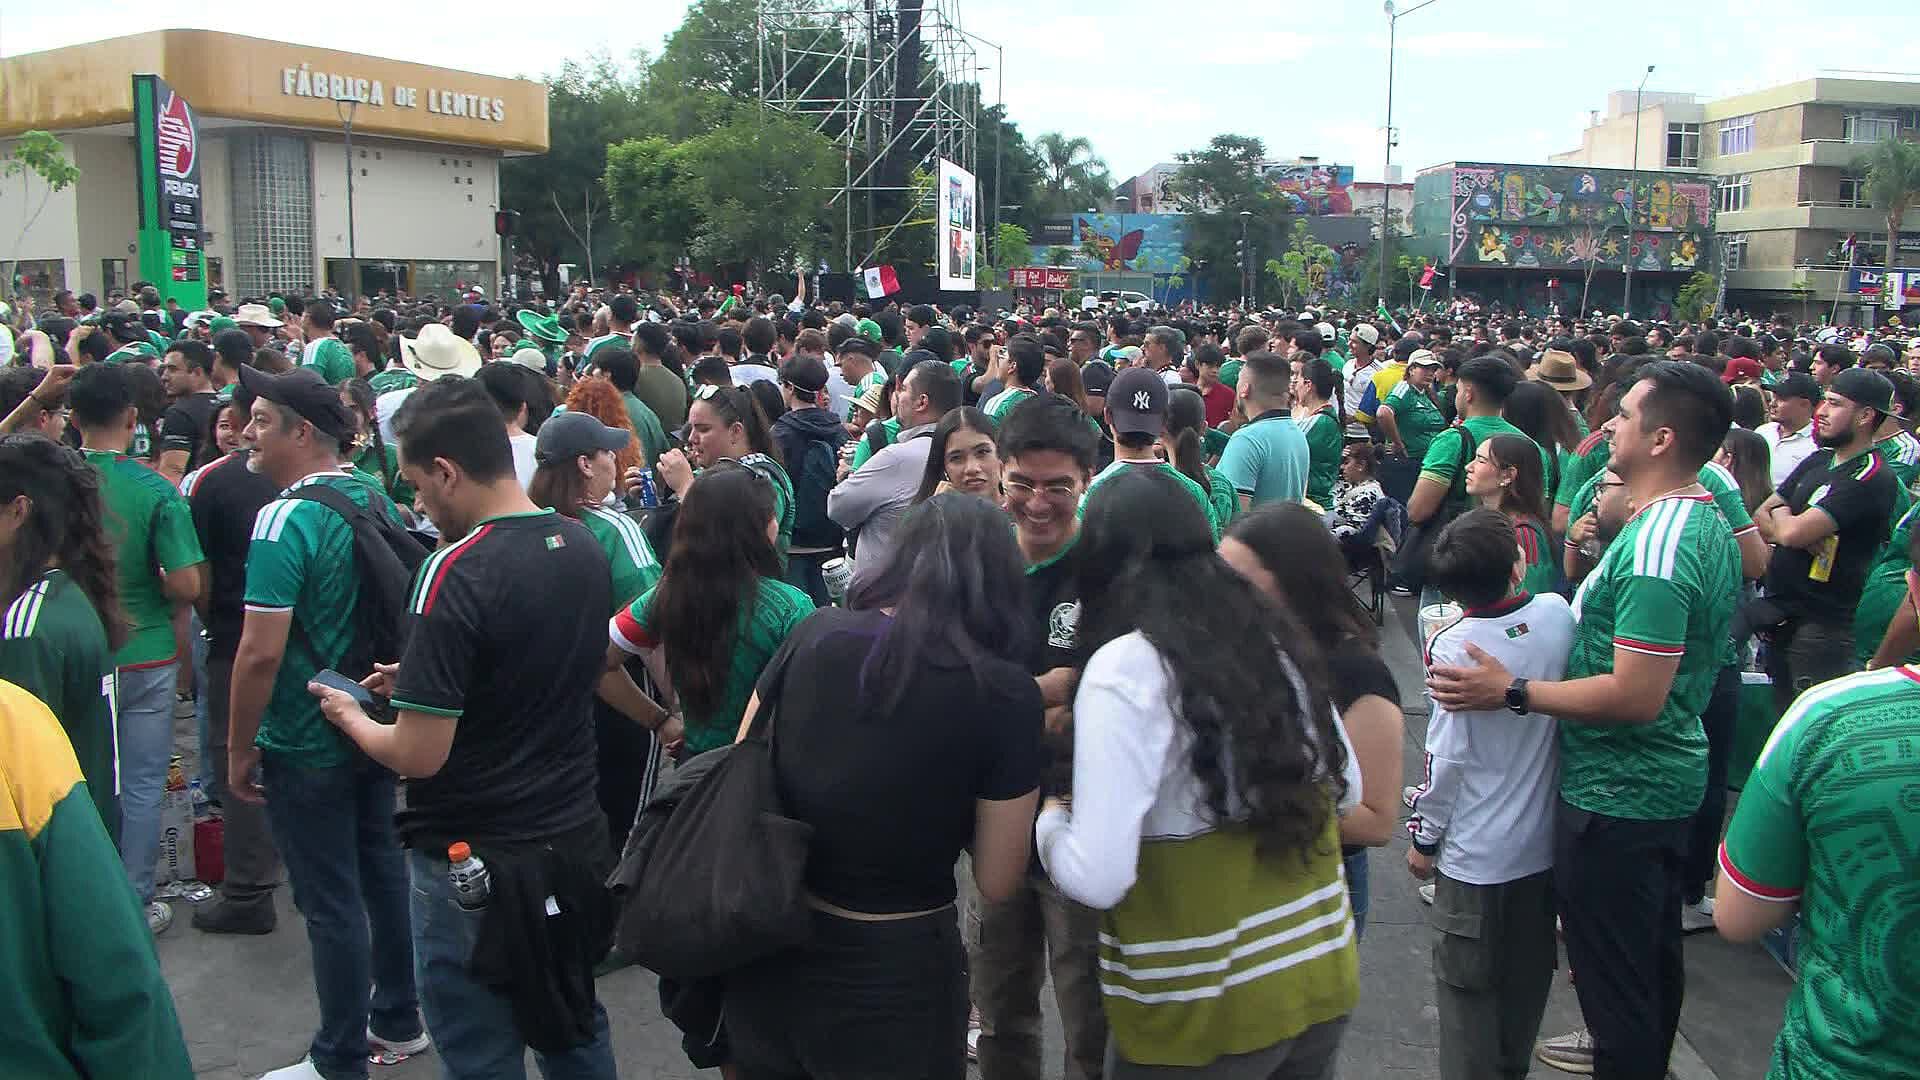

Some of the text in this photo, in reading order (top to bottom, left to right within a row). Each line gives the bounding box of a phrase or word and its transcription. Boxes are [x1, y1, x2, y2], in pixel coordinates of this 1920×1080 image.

[281, 62, 505, 122] FÁBRICA DE LENTES
